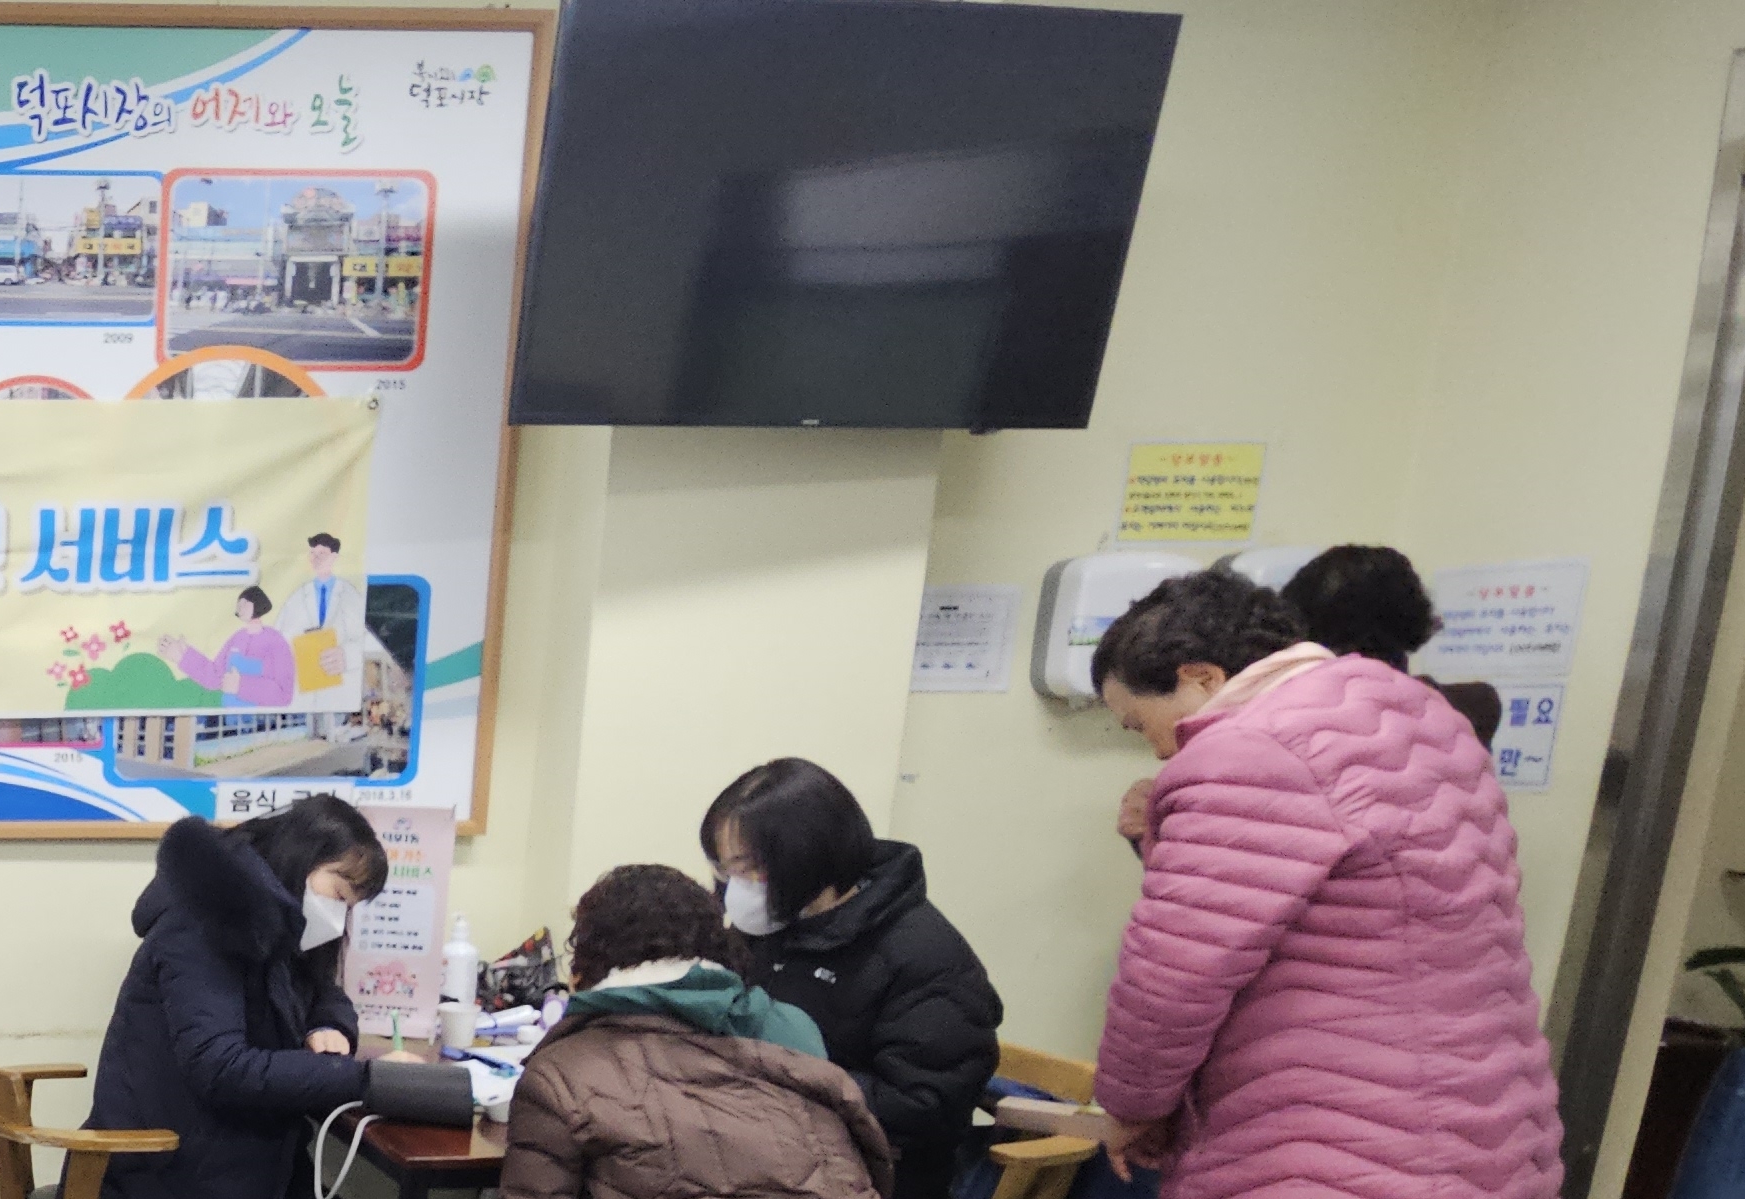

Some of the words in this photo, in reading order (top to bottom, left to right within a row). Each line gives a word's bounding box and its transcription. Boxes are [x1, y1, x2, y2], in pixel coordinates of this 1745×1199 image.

[15, 74, 172, 136] 덕포시장의
[191, 87, 293, 127] 어제와
[310, 74, 357, 147] 오늘
[104, 333, 133, 344] 2009
[20, 507, 250, 584] 서비스
[230, 789, 277, 813] 음식
